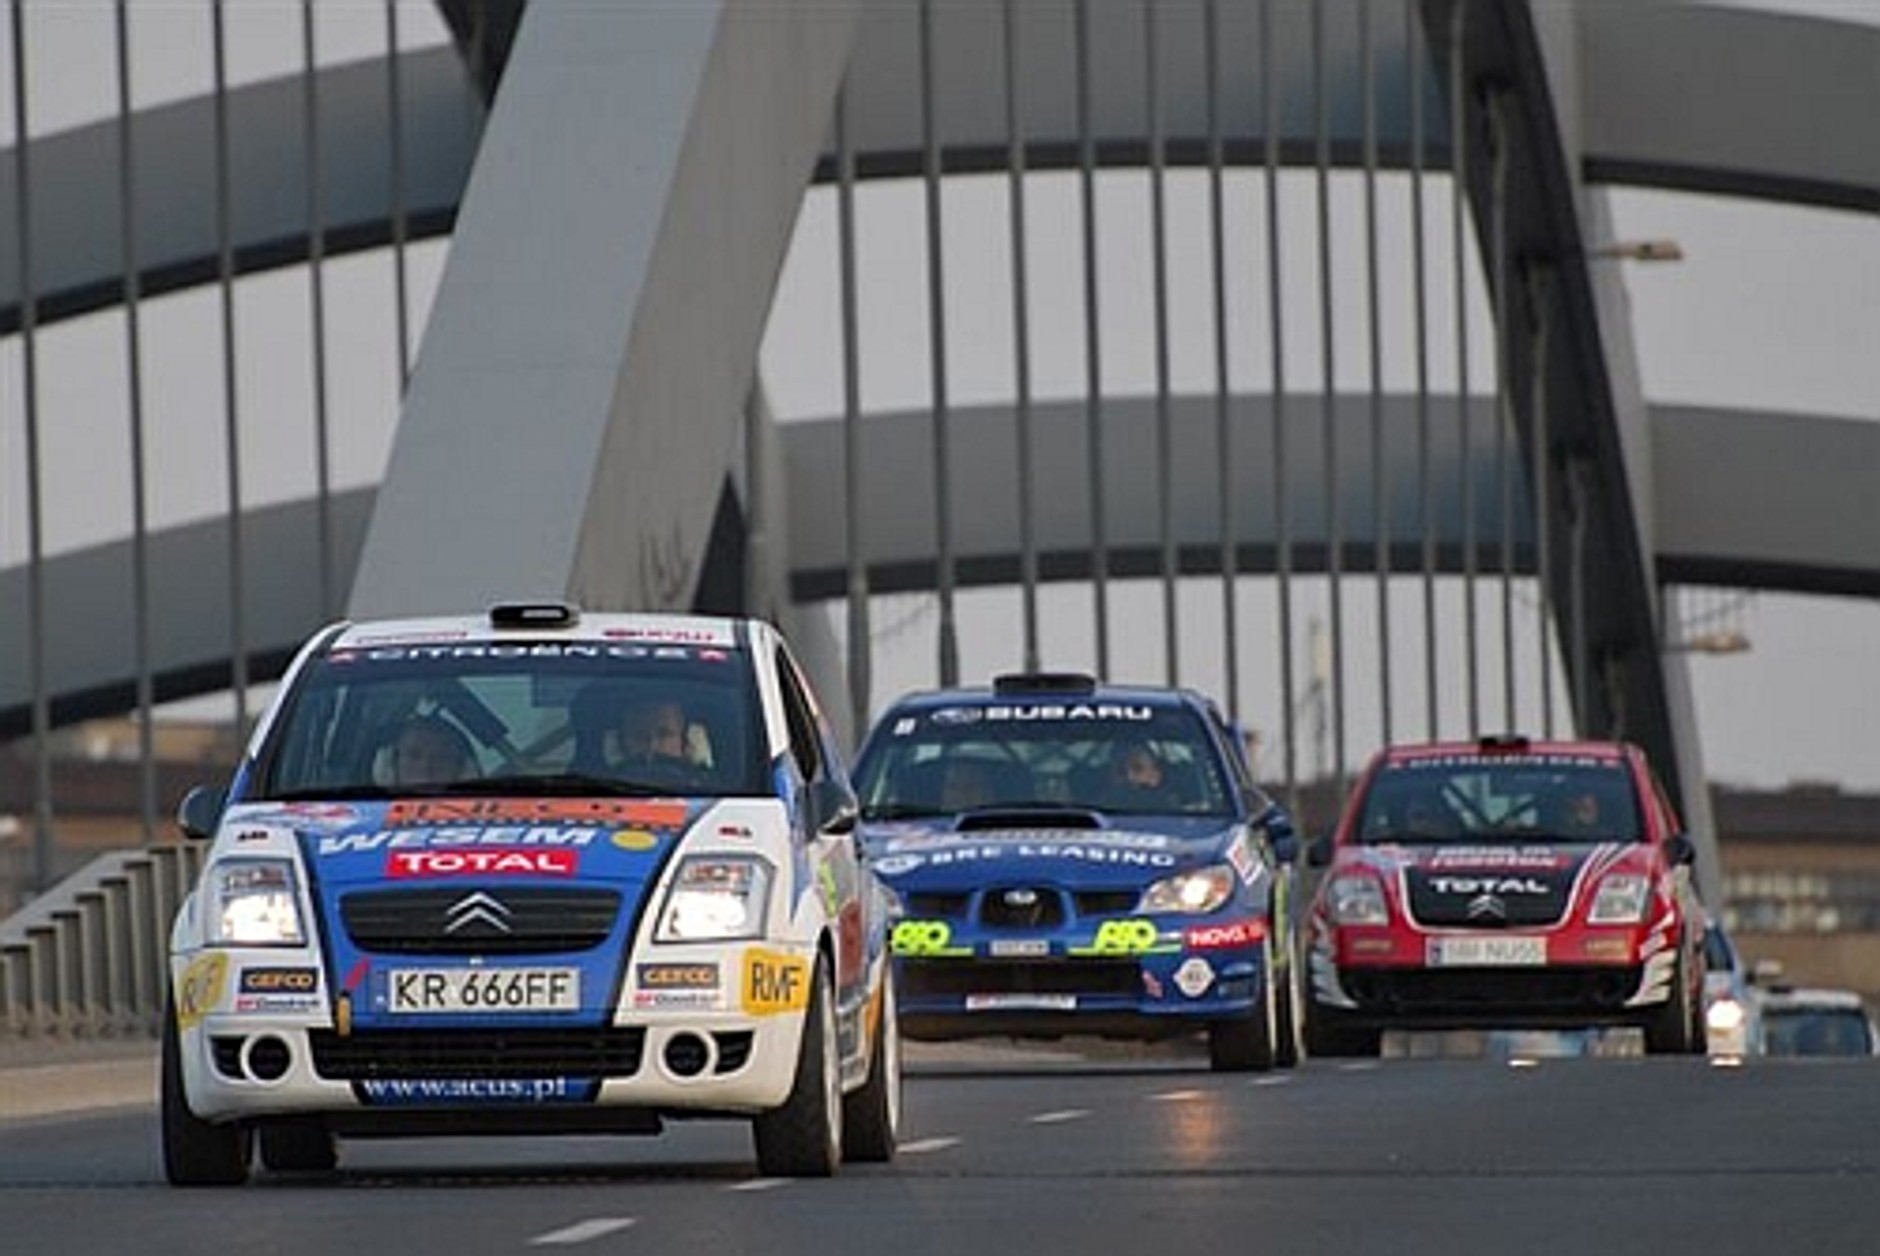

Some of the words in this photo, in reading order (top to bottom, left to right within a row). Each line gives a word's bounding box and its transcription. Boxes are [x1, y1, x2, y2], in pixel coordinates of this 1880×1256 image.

[985, 705, 1151, 721] SUBARU
[319, 826, 598, 855] WESEM
[400, 851, 567, 873] TOTAL
[930, 844, 1001, 866] BRE
[1017, 844, 1176, 867] LEASING
[1429, 876, 1549, 893] TOTAL
[244, 972, 314, 989] GEFCO
[643, 967, 715, 984] GEFCO
[751, 961, 803, 1003] RMF
[394, 973, 447, 1008] KR
[460, 972, 571, 1007] 666FF
[363, 1076, 567, 1100] www.acus.pl
